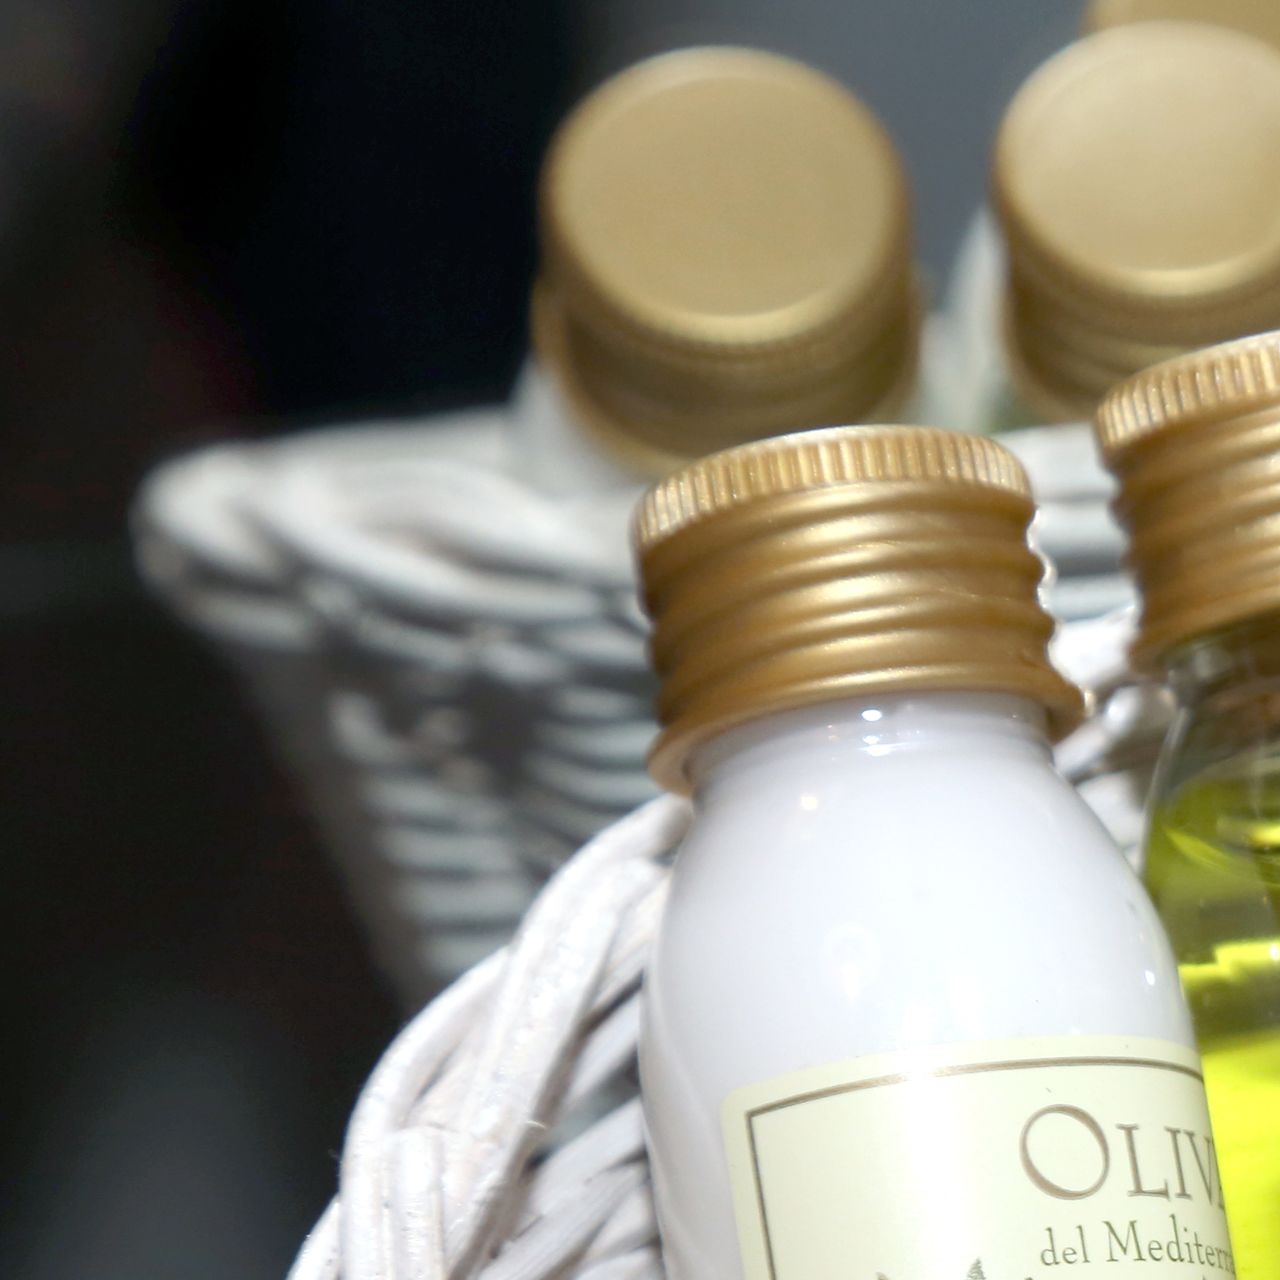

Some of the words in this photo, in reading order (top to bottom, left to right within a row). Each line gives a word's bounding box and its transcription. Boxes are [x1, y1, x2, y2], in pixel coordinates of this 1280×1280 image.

[1019, 1104, 1224, 1209] OLIV
[1040, 1225, 1091, 1266] del
[1102, 1214, 1235, 1274] Mediterr
